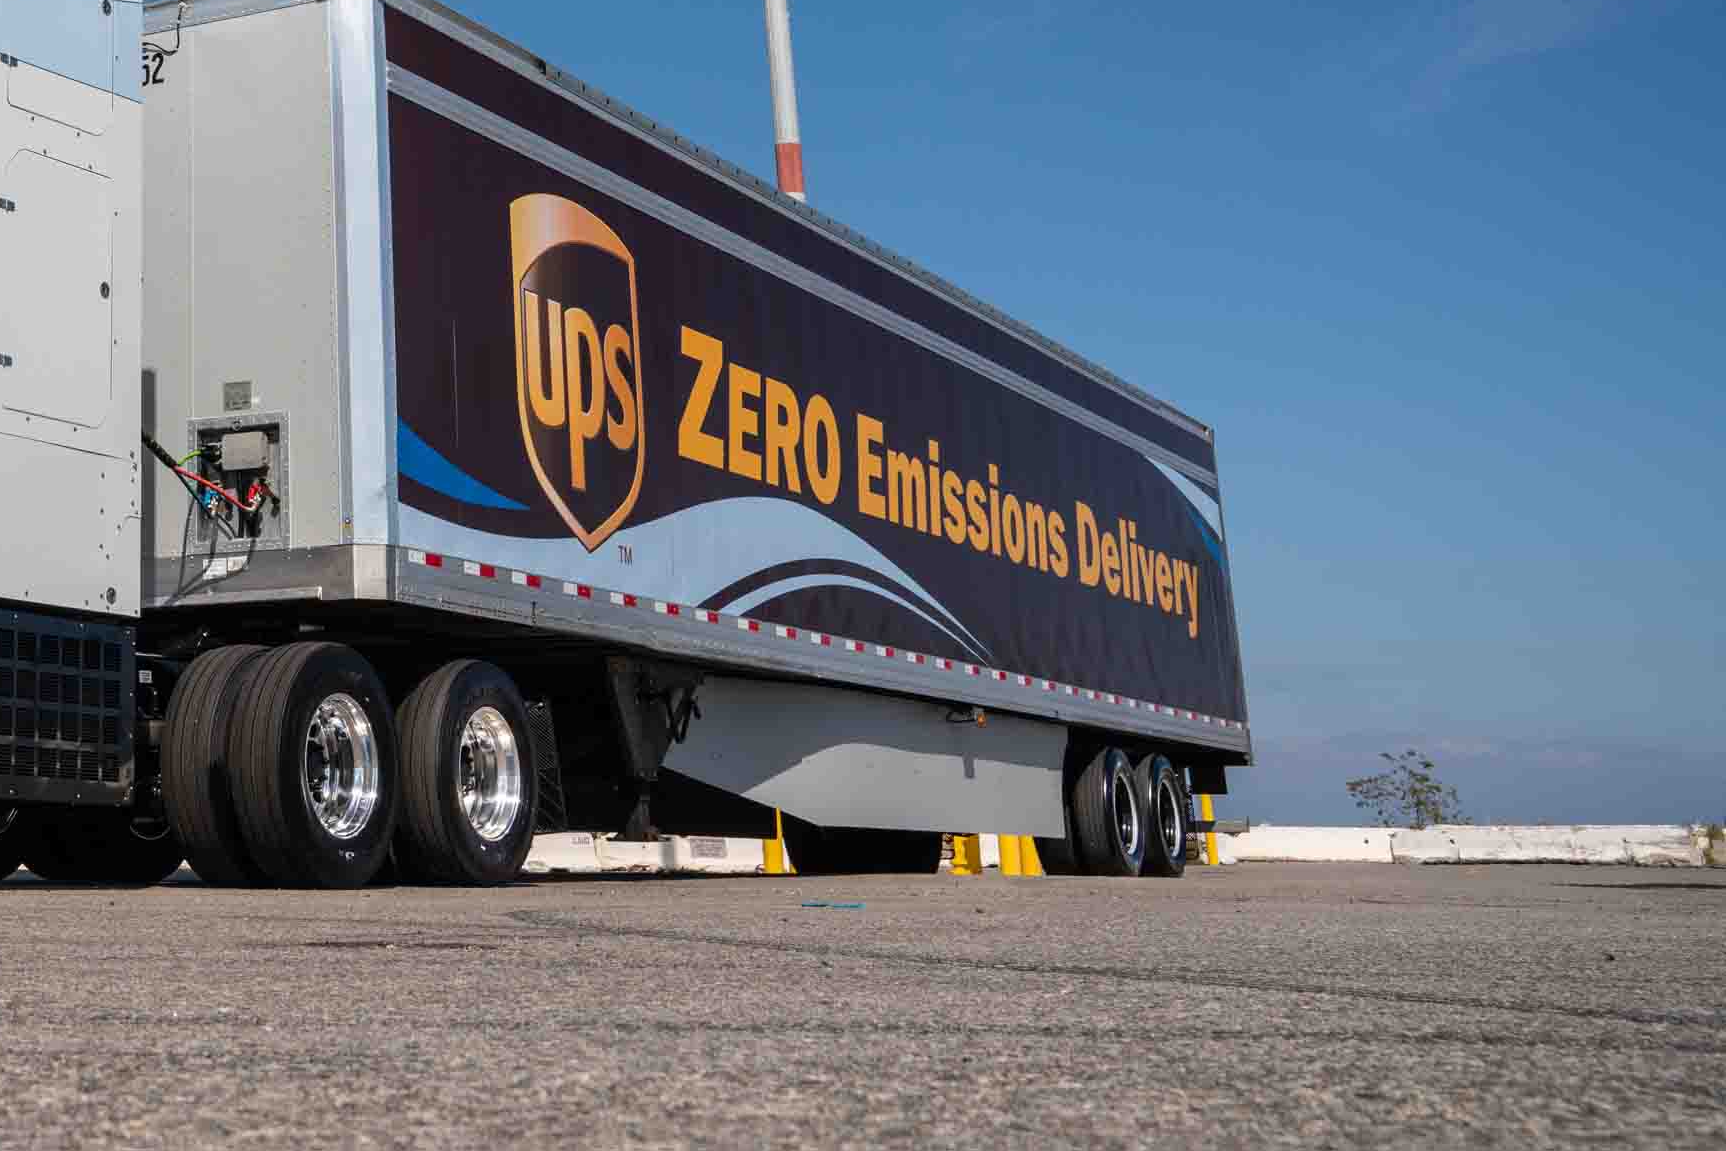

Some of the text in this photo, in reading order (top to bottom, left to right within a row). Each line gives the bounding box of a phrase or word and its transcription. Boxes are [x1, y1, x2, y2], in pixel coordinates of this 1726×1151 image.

[524, 288, 636, 492] ups
[677, 324, 1200, 640] ZERO Emissions Delivery
[618, 545, 633, 566] TM
